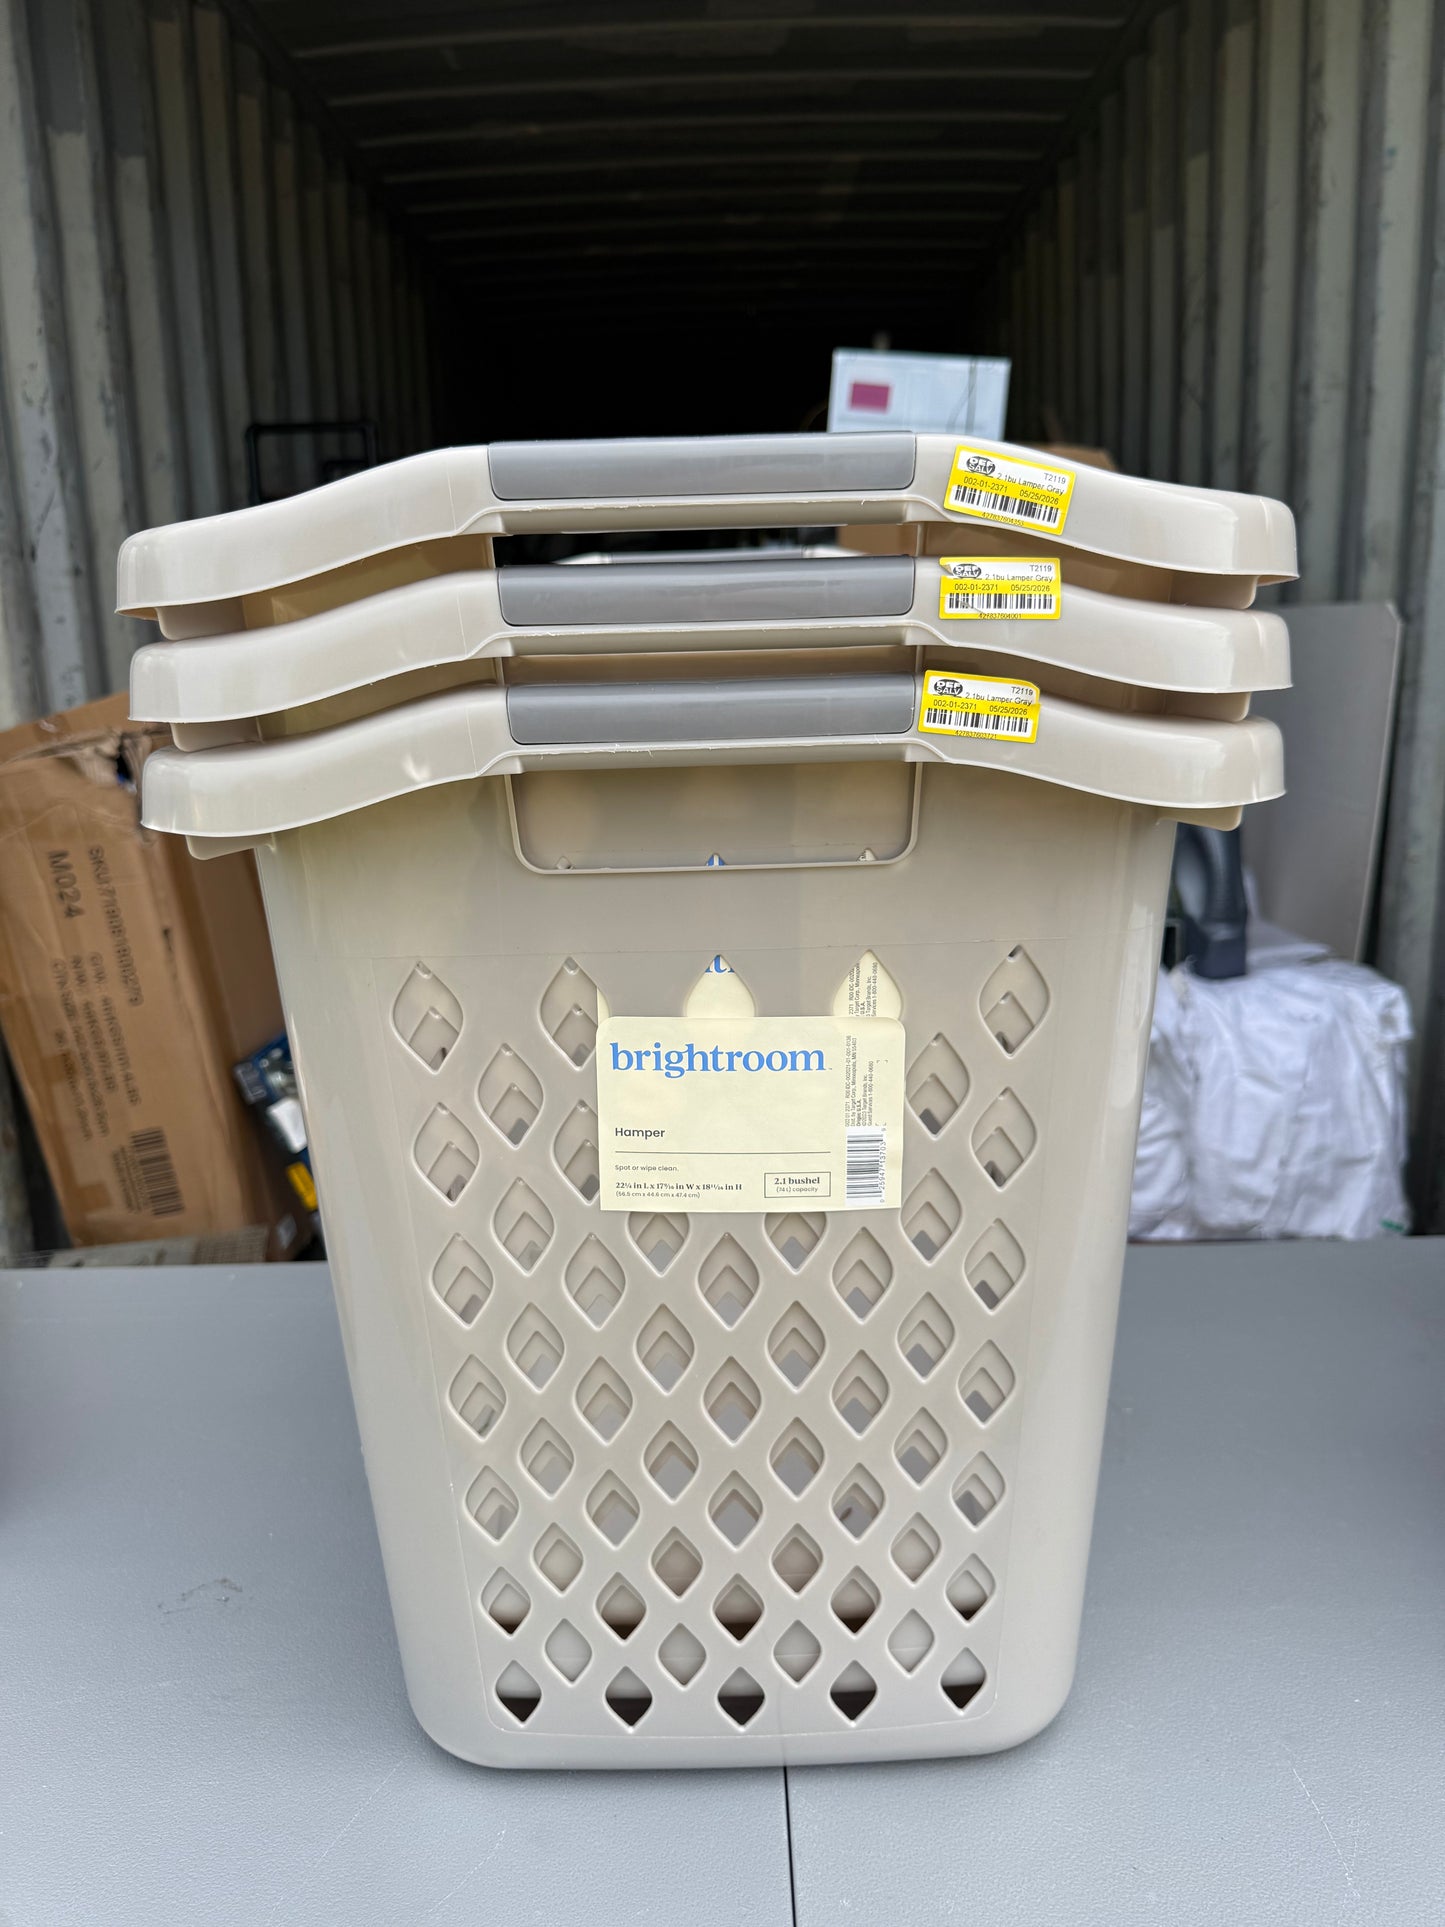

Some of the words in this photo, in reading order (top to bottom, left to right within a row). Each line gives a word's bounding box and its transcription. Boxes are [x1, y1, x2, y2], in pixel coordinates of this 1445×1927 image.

[1044, 472, 1066, 484] T2119
[964, 476, 1008, 492] 002-01-2371
[1020, 490, 1059, 505] 05/25/2026
[1018, 476, 1045, 492] Lamper
[1047, 484, 1064, 496] Gray
[1007, 574, 1032, 582] Lamper
[1036, 574, 1052, 583] Gray
[1010, 584, 1050, 592] 05/25/2026
[1011, 686, 1033, 696] T2119
[987, 694, 1012, 704] Lamper
[1014, 697, 1032, 706] Gray
[934, 700, 976, 710] 002-01-2371
[989, 705, 1028, 715] 05/25/2026
[49, 850, 84, 918] M024
[610, 1042, 824, 1078] brightroom
[615, 1128, 665, 1140] Hamper
